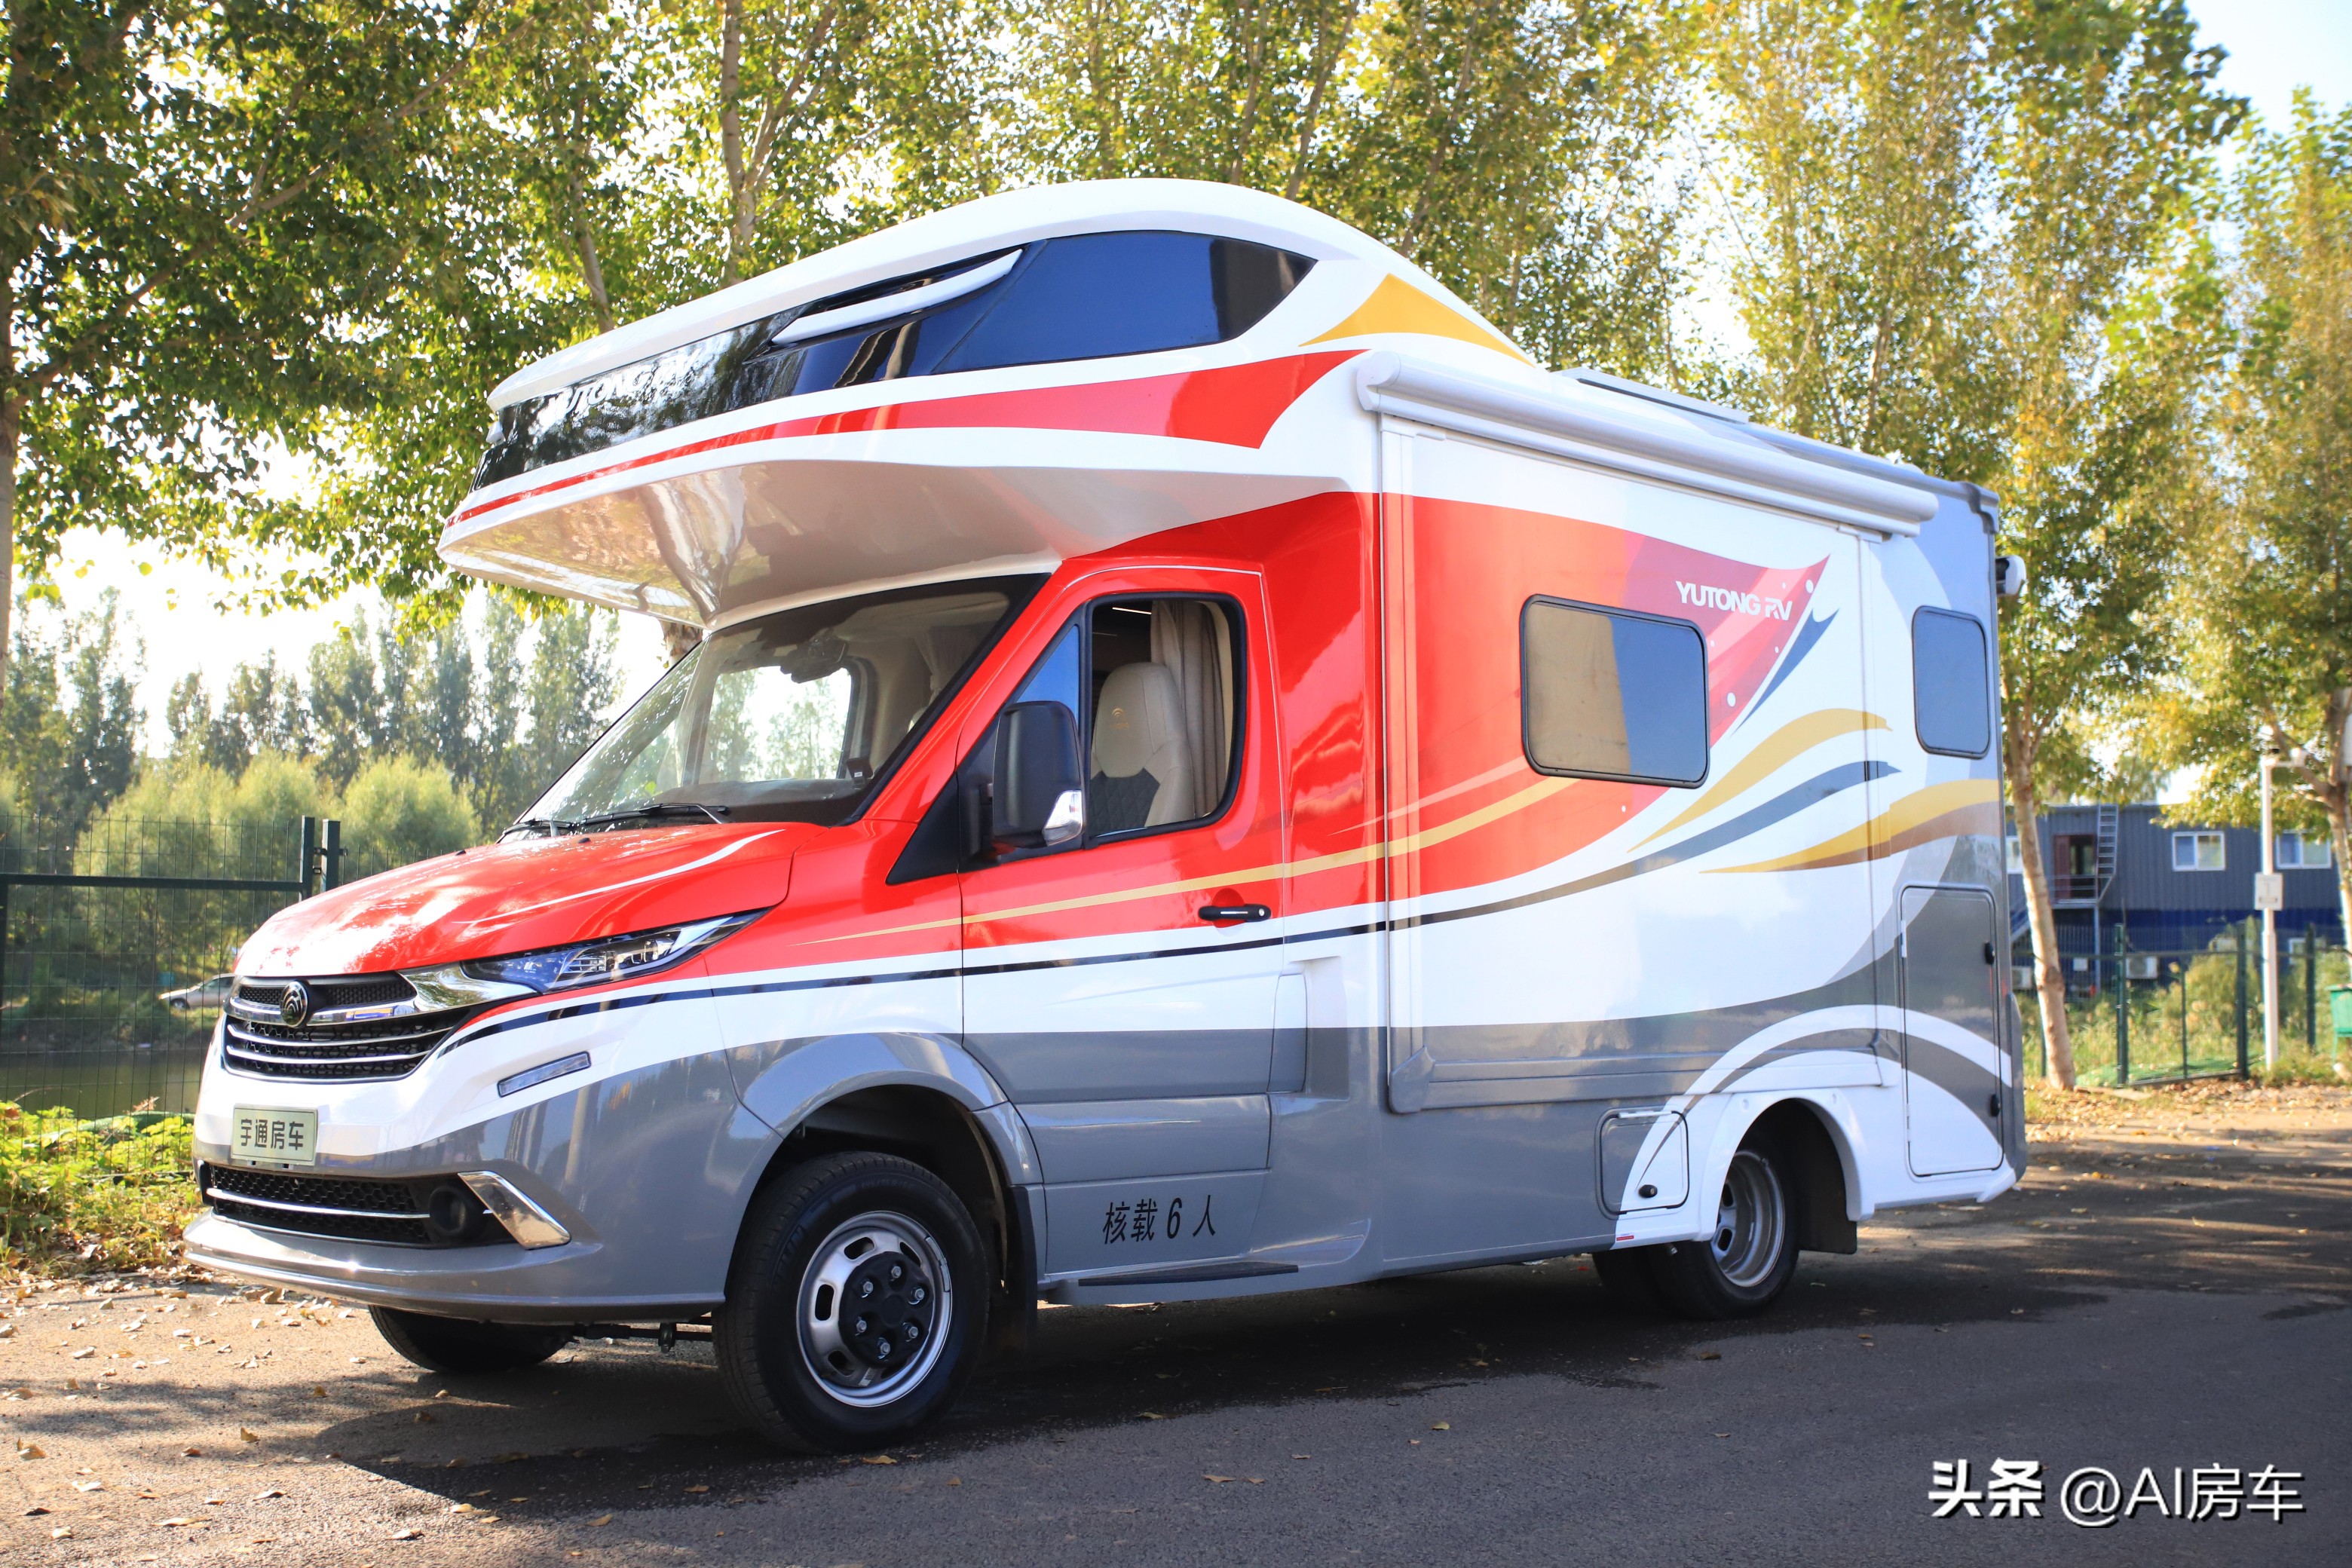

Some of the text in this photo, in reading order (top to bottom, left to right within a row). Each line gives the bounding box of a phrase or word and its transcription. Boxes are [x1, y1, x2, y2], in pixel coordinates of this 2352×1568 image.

[1675, 580, 1793, 621] YUTONG RV
[240, 1119, 304, 1150] 宇通房车
